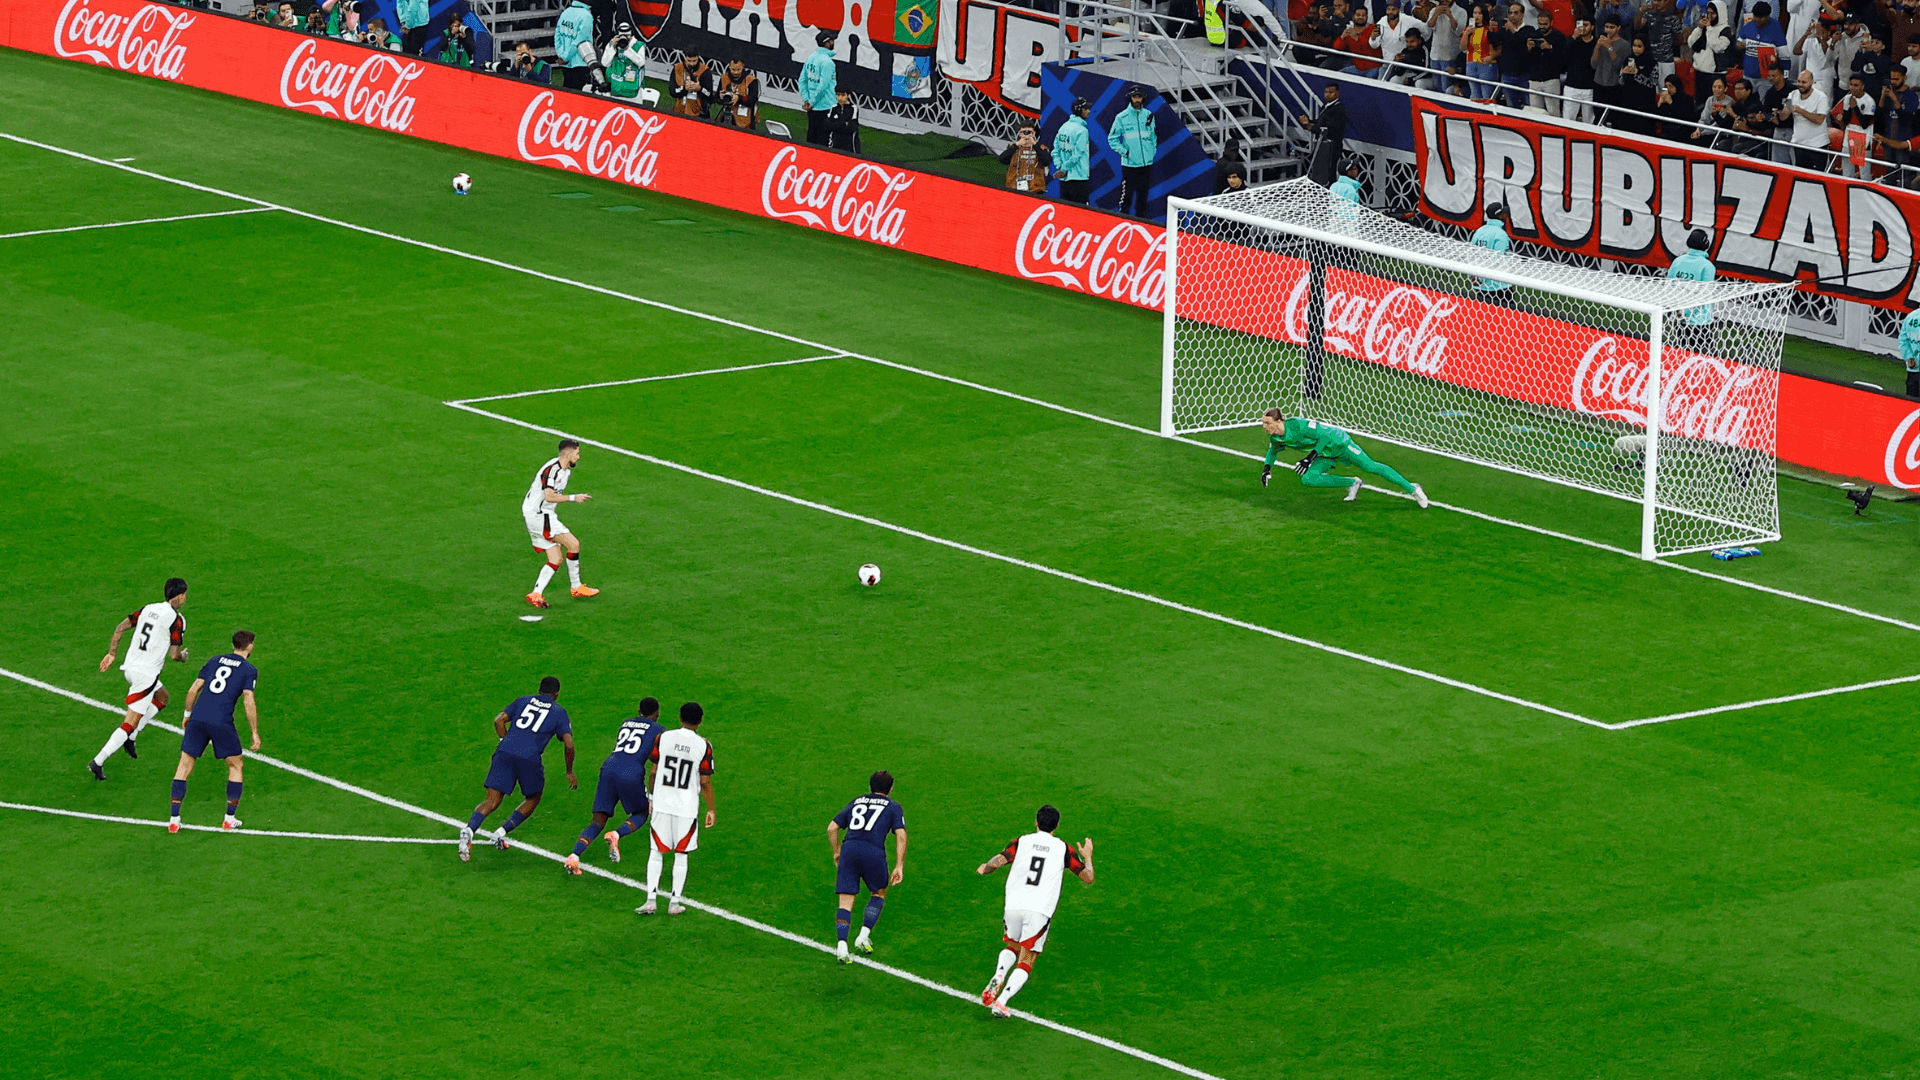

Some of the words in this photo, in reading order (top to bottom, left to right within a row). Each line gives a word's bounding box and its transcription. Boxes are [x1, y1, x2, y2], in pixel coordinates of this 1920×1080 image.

[53, 0, 197, 80] Coca-Cola
[280, 39, 425, 132] Coca-Cola
[516, 91, 668, 188] Coca-Cola
[761, 146, 915, 246] Coca-Cola
[1419, 110, 1920, 304] URUBUZAD
[1015, 204, 1168, 308] Coca-Cola
[139, 621, 154, 651] 5
[209, 665, 232, 694] 8
[515, 703, 550, 733] 51
[613, 728, 646, 754] 25
[662, 755, 694, 790] 50
[849, 803, 886, 831] 87
[1032, 843, 1050, 853] PEDRO
[1025, 855, 1046, 887] 9
